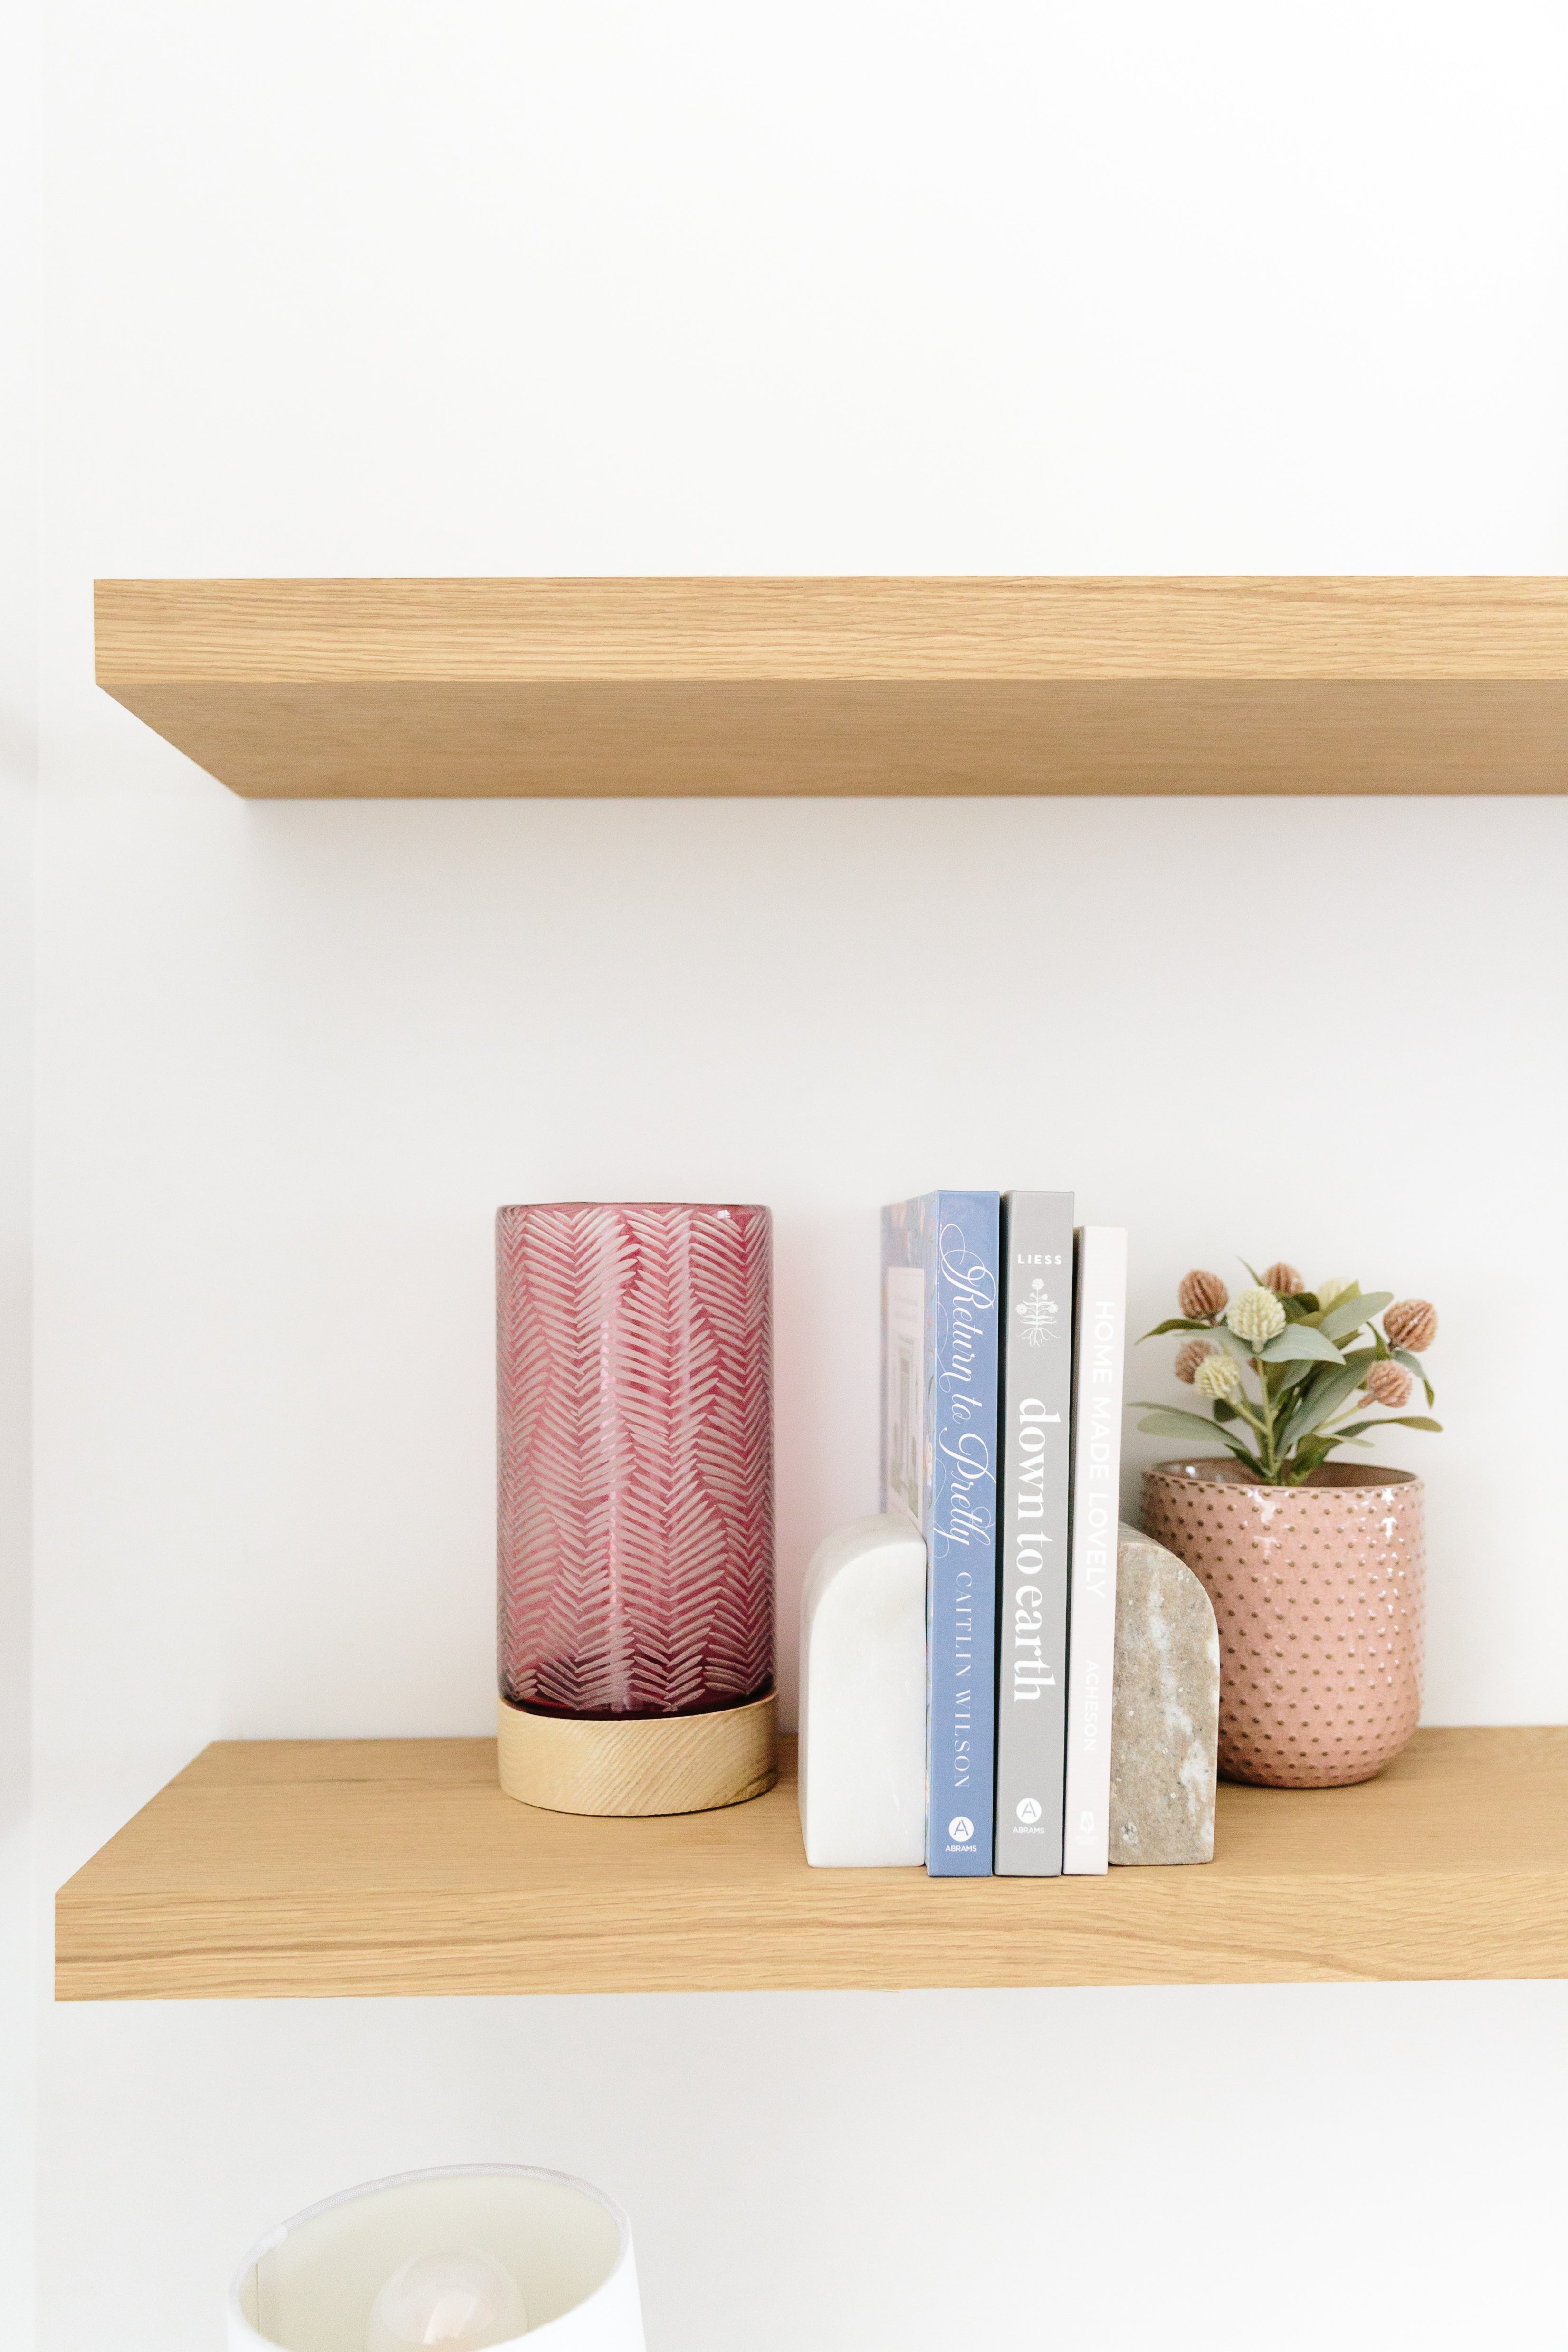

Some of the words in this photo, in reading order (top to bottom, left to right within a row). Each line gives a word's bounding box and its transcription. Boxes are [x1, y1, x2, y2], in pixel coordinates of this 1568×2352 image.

[937, 1224, 996, 1393] Return
[1018, 1254, 1061, 1265] LIESS
[1094, 1301, 1115, 1384] HOME
[952, 1393, 982, 1424] to
[1090, 1397, 1111, 1480] MADE
[934, 1427, 996, 1558] Pretty
[1017, 1398, 1061, 1520] down
[1016, 1531, 1053, 1574] to
[1086, 1492, 1109, 1597] LOVELY
[956, 1572, 972, 1677] CAITLIN
[1014, 1585, 1055, 1702] earth
[954, 1690, 971, 1788] WILSON
[1083, 1660, 1100, 1751] ACHESON
